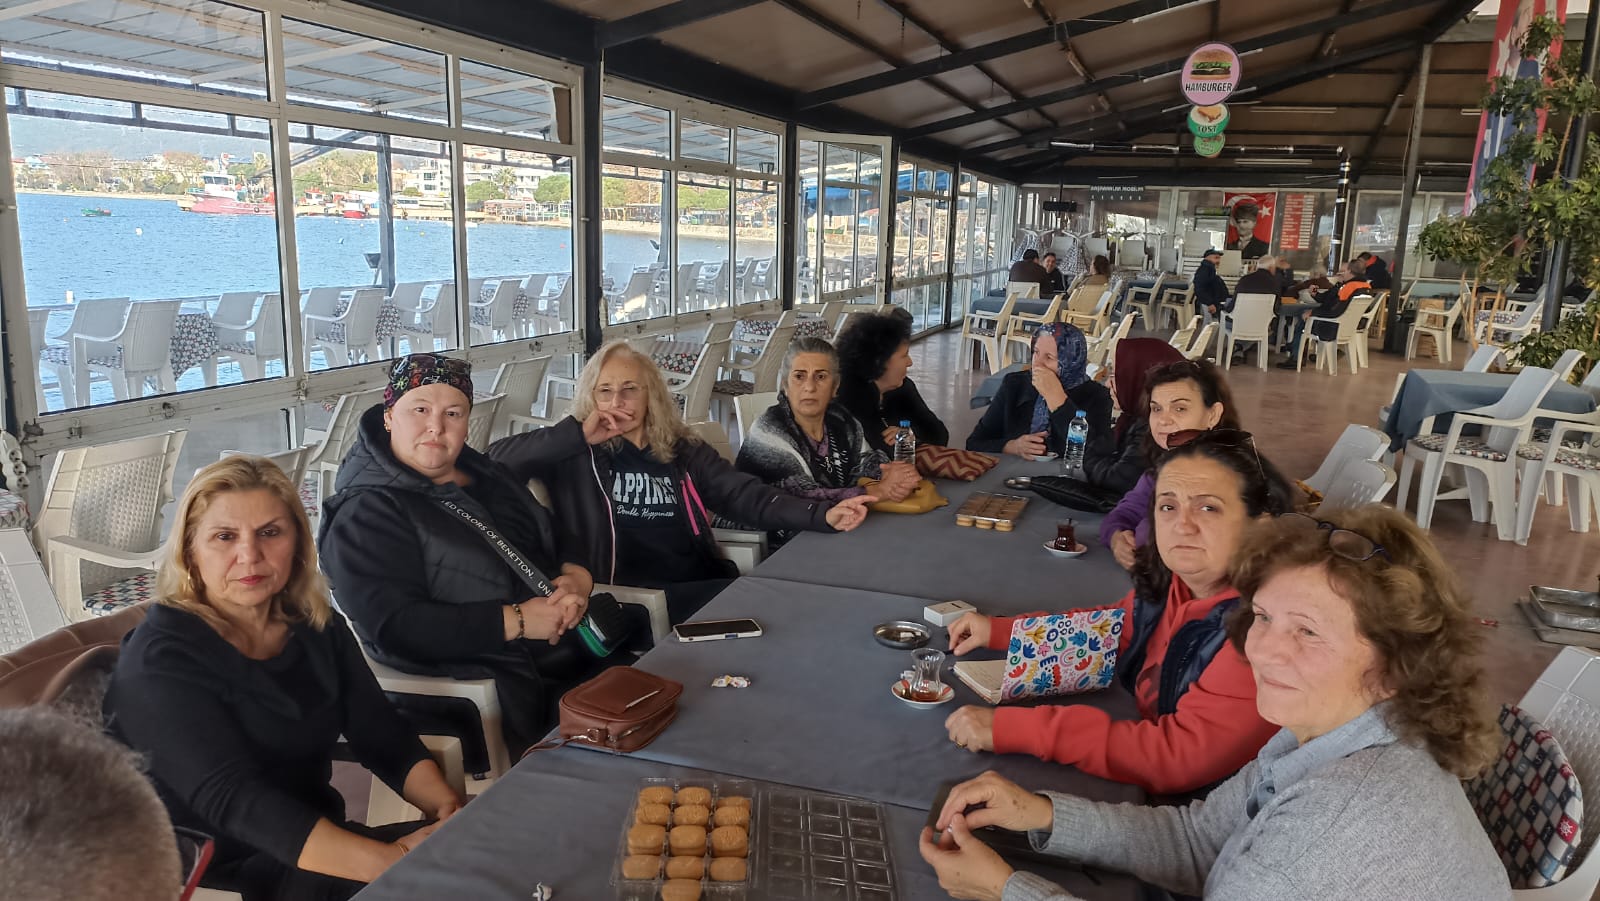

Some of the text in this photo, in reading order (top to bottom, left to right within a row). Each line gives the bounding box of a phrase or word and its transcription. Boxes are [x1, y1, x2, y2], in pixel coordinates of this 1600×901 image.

[1185, 82, 1233, 92] HAMBURGER
[610, 470, 678, 504] APPINES
[441, 500, 457, 510] ED
[456, 508, 488, 531] COLORS
[486, 530, 499, 540] OF
[617, 504, 640, 516] Double
